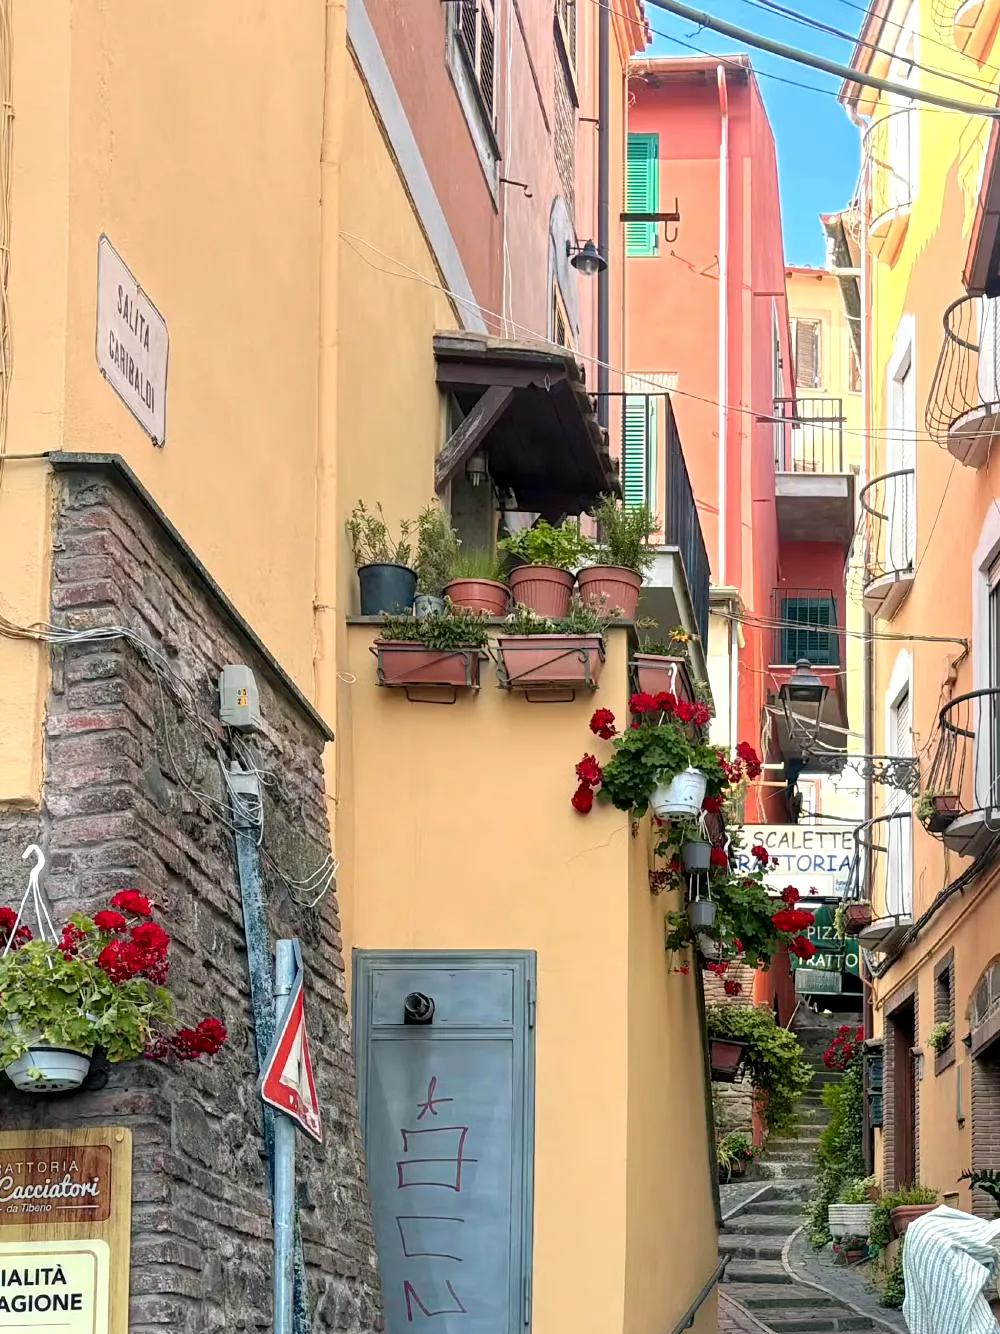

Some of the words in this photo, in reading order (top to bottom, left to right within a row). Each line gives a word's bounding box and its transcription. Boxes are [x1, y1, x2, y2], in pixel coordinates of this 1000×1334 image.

[117, 284, 150, 353] SALITA
[753, 831, 853, 850] SCALETTE
[735, 854, 852, 872] RTTORIA
[0, 1160, 79, 1174] ATTORIA
[0, 1173, 100, 1203] Cacciatori
[6, 1204, 18, 1213] da
